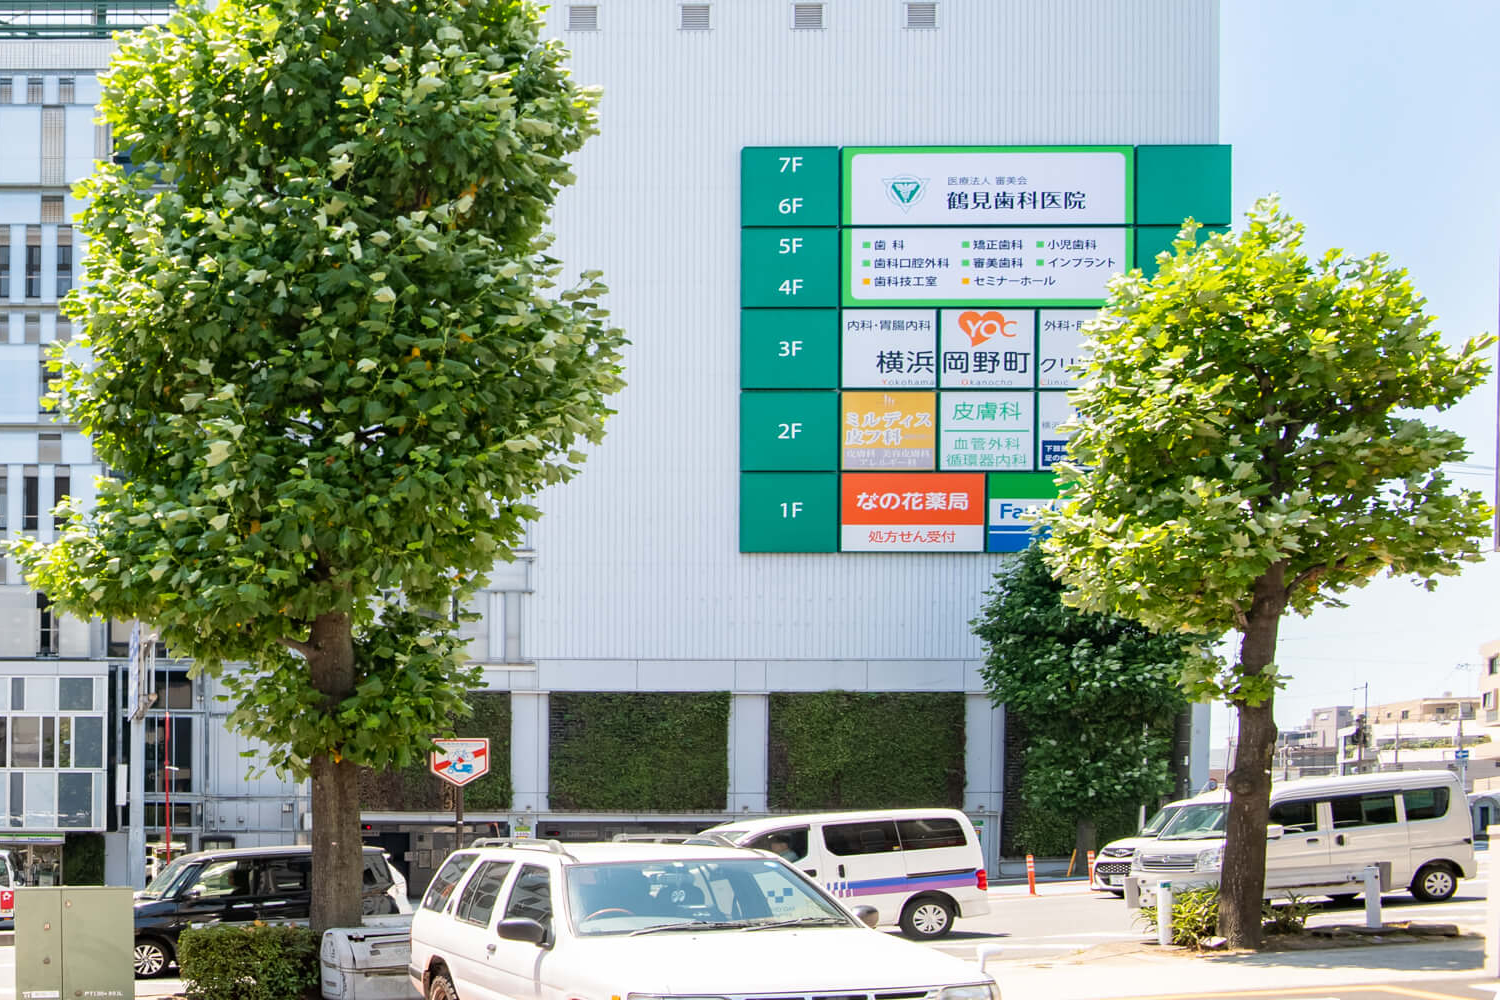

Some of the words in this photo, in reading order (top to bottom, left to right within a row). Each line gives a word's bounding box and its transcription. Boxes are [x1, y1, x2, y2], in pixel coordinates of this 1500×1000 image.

[779, 156, 803, 173] 7F
[947, 176, 991, 186] 医療法人
[995, 176, 1029, 186] 審美会
[778, 198, 803, 214] 6F
[946, 191, 1087, 210] 鶴見歯科医院
[778, 238, 803, 254] 5F
[972, 239, 1023, 250] 矯正歯科
[1047, 239, 1097, 250] 小児歯科
[874, 257, 950, 269] 歯科口腔外科
[973, 257, 1023, 269] 審美歯科
[1048, 257, 1116, 268] インプラント
[778, 279, 803, 295] 4F
[874, 276, 938, 287] 歯科技工室
[973, 275, 1056, 286] セミナーホール
[778, 341, 803, 356] 3F
[952, 401, 1022, 421] 皮膚科
[845, 411, 932, 428] ミルディス
[778, 423, 802, 439] 2F
[845, 428, 902, 445] 皮フ科
[954, 437, 1021, 450] 血管外科
[946, 453, 1027, 467] 循環器内科
[856, 492, 969, 511] なの花薬局
[780, 502, 803, 518] 1F
[868, 530, 956, 544] 処方せん受付
